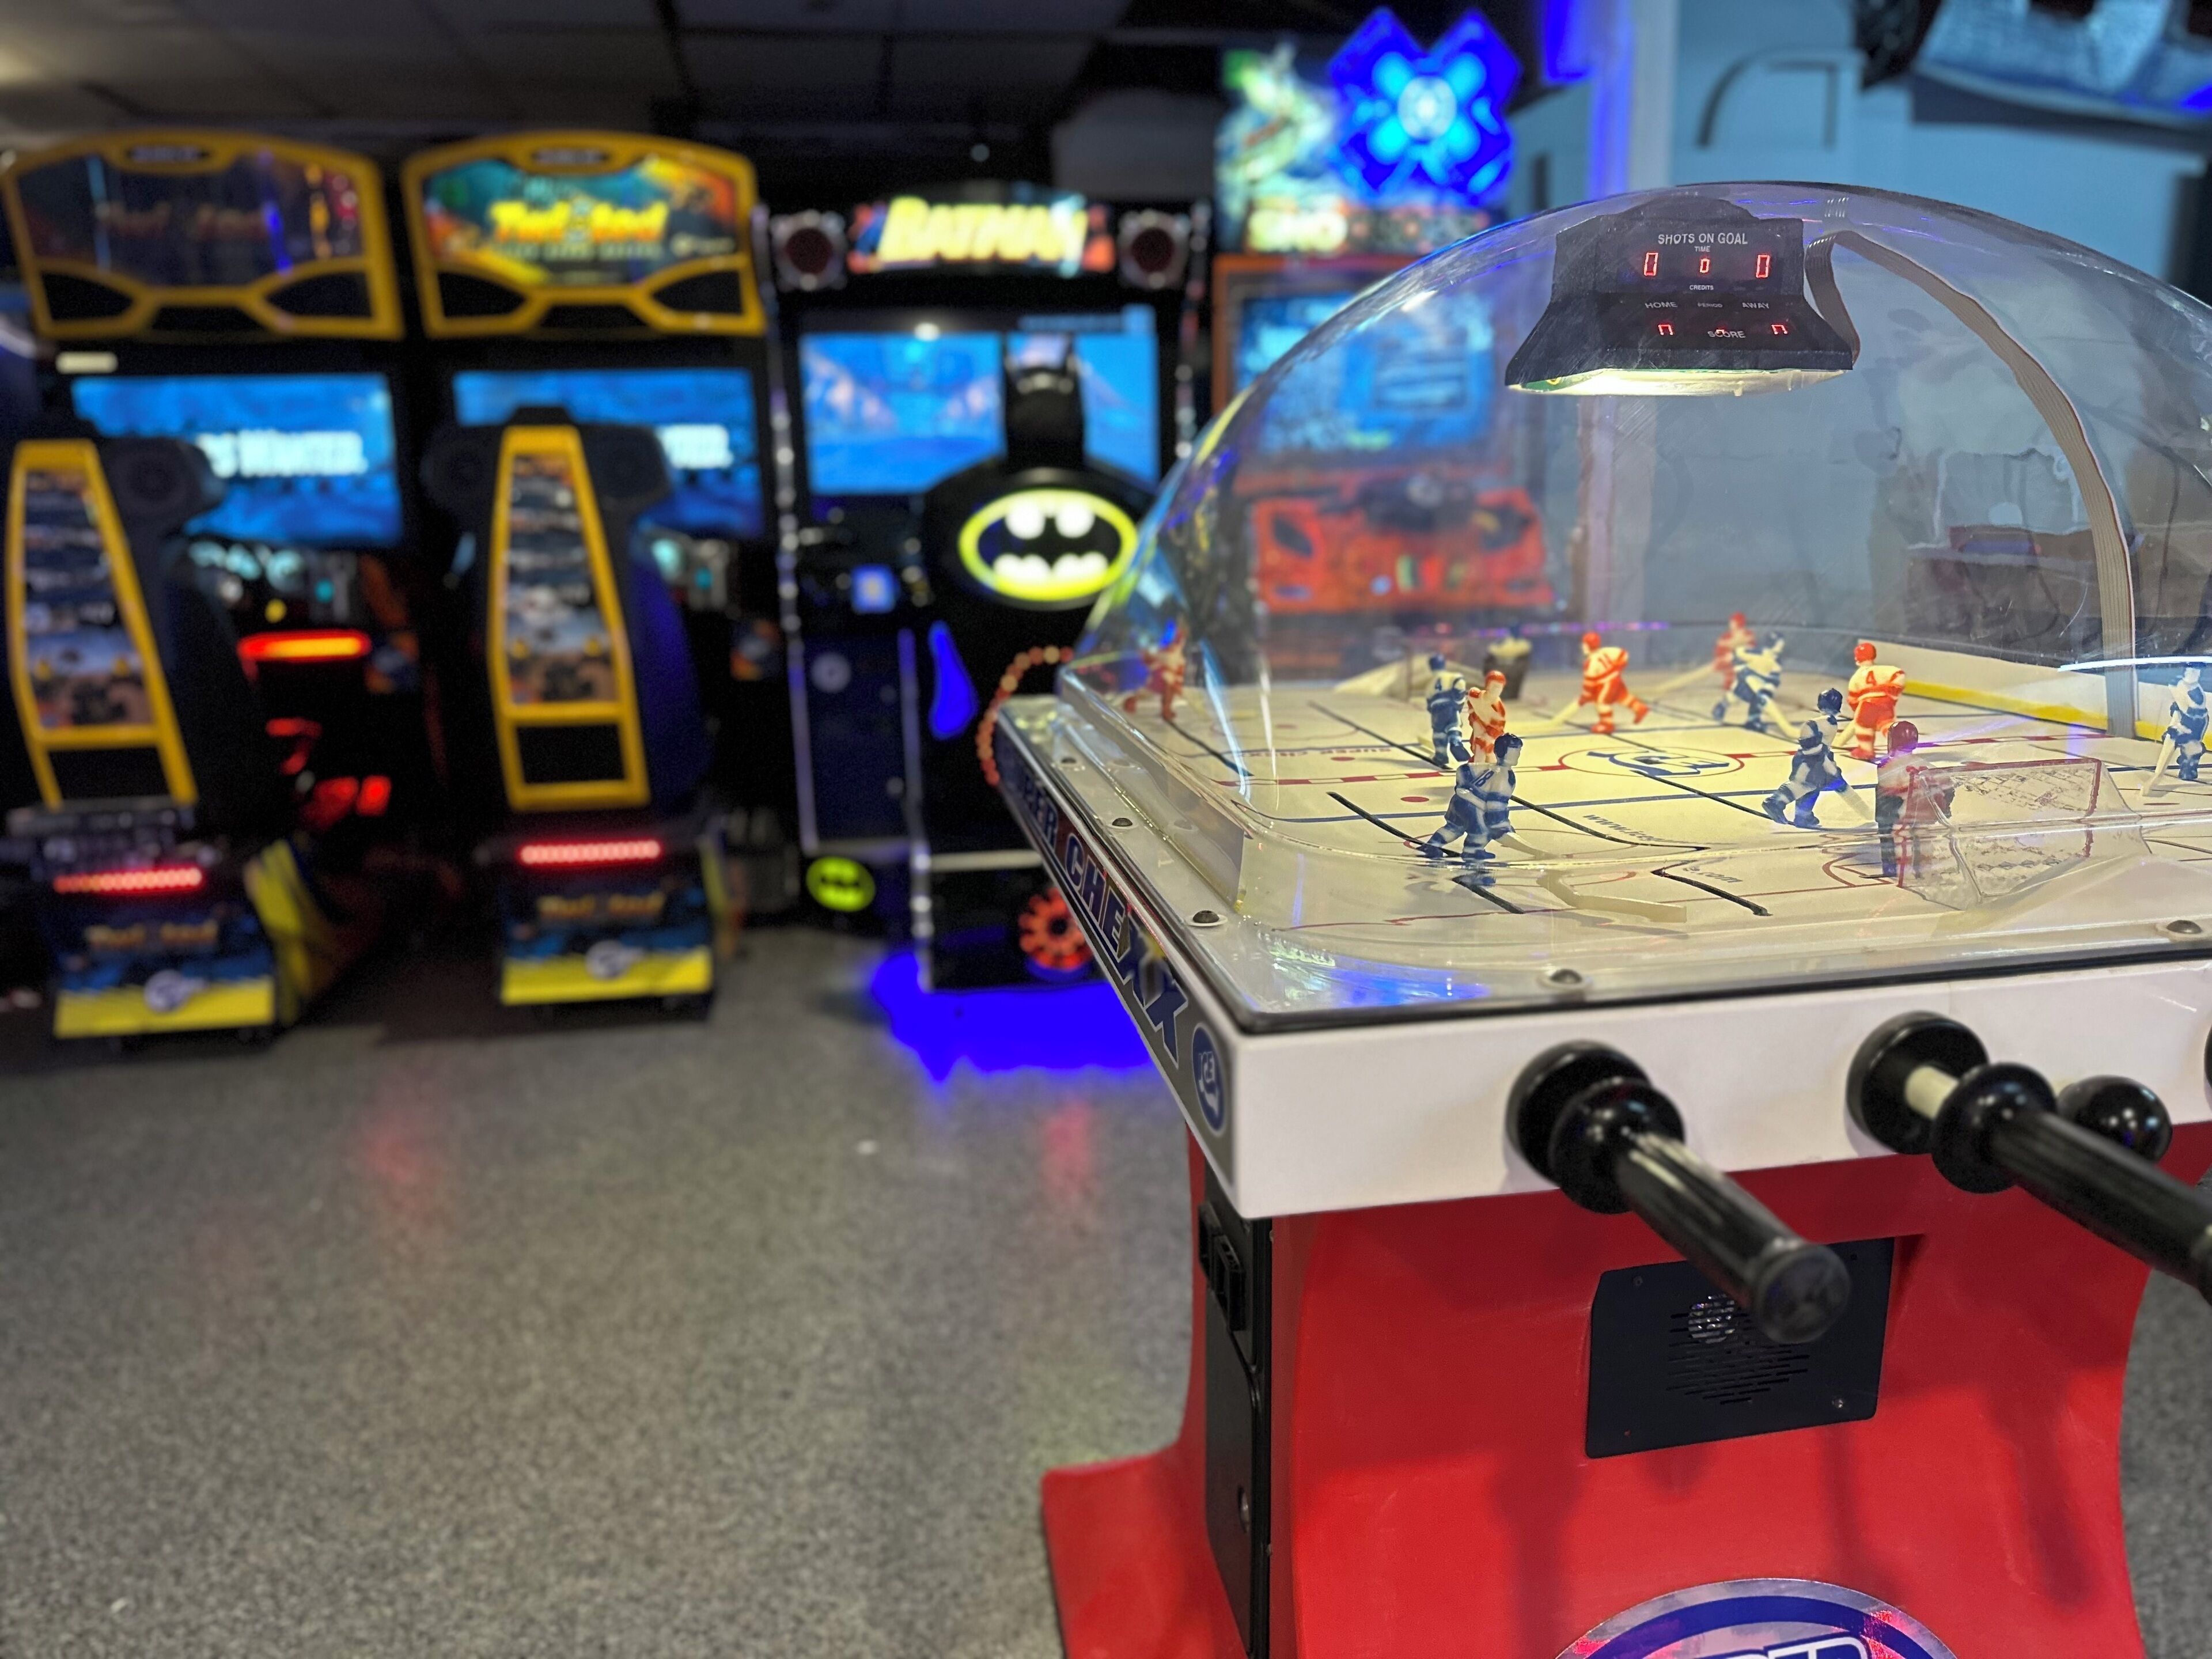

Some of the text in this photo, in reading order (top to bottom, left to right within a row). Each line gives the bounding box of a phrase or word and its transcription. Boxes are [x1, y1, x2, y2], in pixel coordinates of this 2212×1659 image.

[1658, 232, 1748, 245] SHOTS ON GOAL
[1707, 331, 1746, 339] SCORE
[1866, 671, 1877, 685] 4
